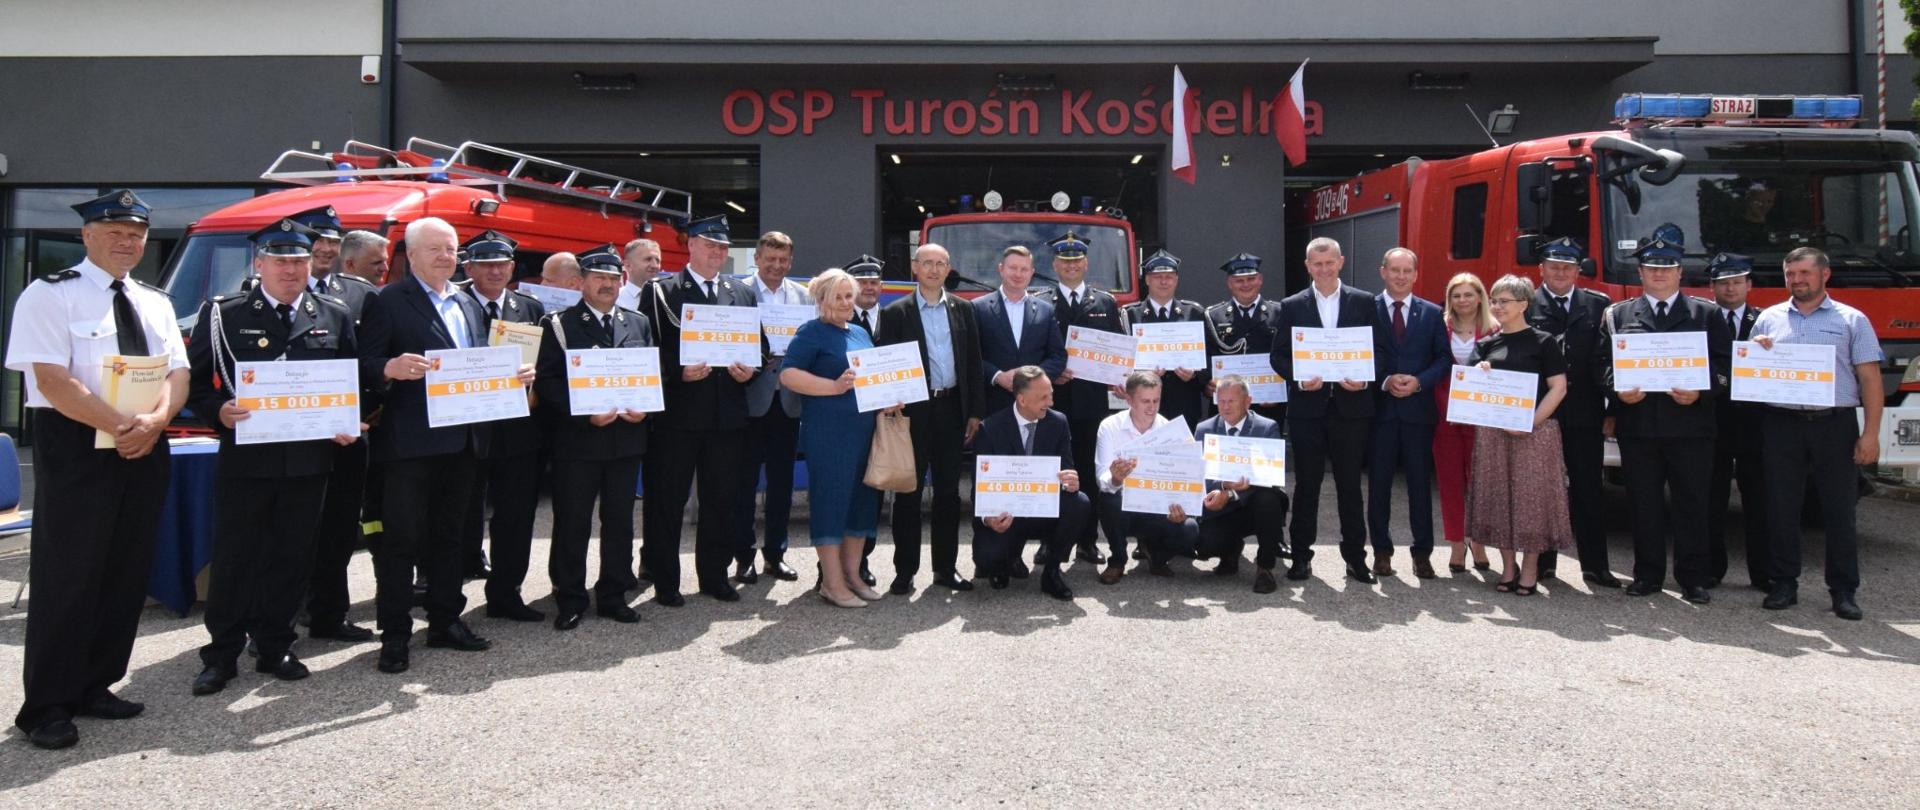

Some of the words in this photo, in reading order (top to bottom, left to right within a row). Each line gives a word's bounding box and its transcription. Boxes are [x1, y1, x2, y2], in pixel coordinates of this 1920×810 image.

[722, 88, 834, 136] OSP
[851, 88, 1040, 136] Turośń
[698, 333, 704, 341] 5
[711, 333, 732, 341] 250
[1164, 343, 1182, 351] 000
[1077, 350, 1089, 359] 20
[1094, 352, 1113, 362] 000
[1310, 351, 1316, 359] 5
[1322, 351, 1344, 360] 000
[1634, 359, 1641, 367] 7
[1648, 359, 1673, 368] 000
[867, 376, 874, 385] 5
[878, 372, 898, 384] 000
[1753, 369, 1761, 377] 3
[1769, 370, 1797, 379] 000
[448, 383, 456, 394] 6
[464, 380, 490, 393] 000
[590, 377, 597, 387] 5
[605, 377, 628, 387] 250
[258, 397, 279, 410] 15
[288, 396, 320, 408] 000
[330, 394, 347, 406] zł
[1468, 391, 1475, 400] 4
[1482, 392, 1504, 404] 000
[988, 483, 1002, 491] 40
[1009, 483, 1031, 492] 000
[1139, 479, 1145, 488] 3
[1152, 480, 1173, 490] 500
